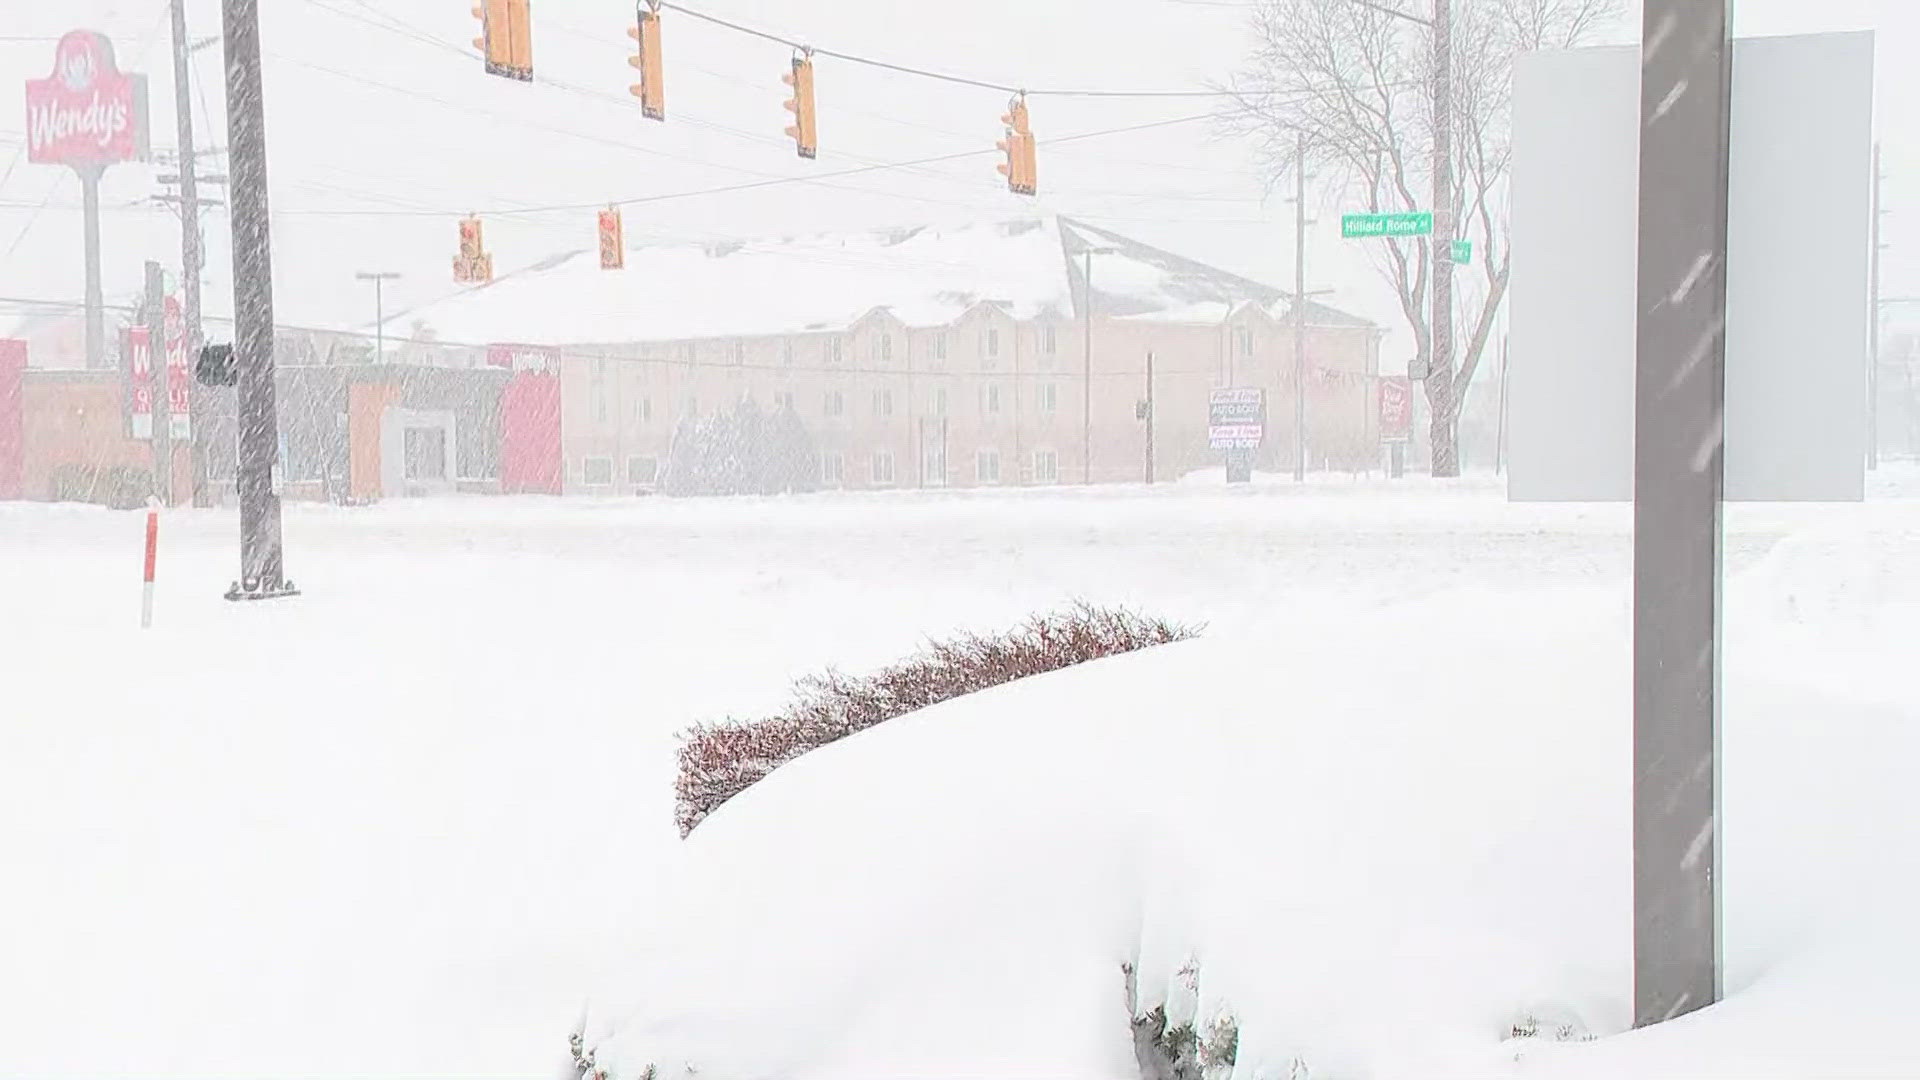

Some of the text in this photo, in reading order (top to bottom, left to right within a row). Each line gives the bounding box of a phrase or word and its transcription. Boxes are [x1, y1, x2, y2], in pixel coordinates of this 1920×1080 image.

[31, 89, 127, 151] Wendy's
[1345, 220, 1384, 233] Hilliard
[1386, 219, 1418, 232] Rome
[1210, 439, 1235, 449] AUTO
